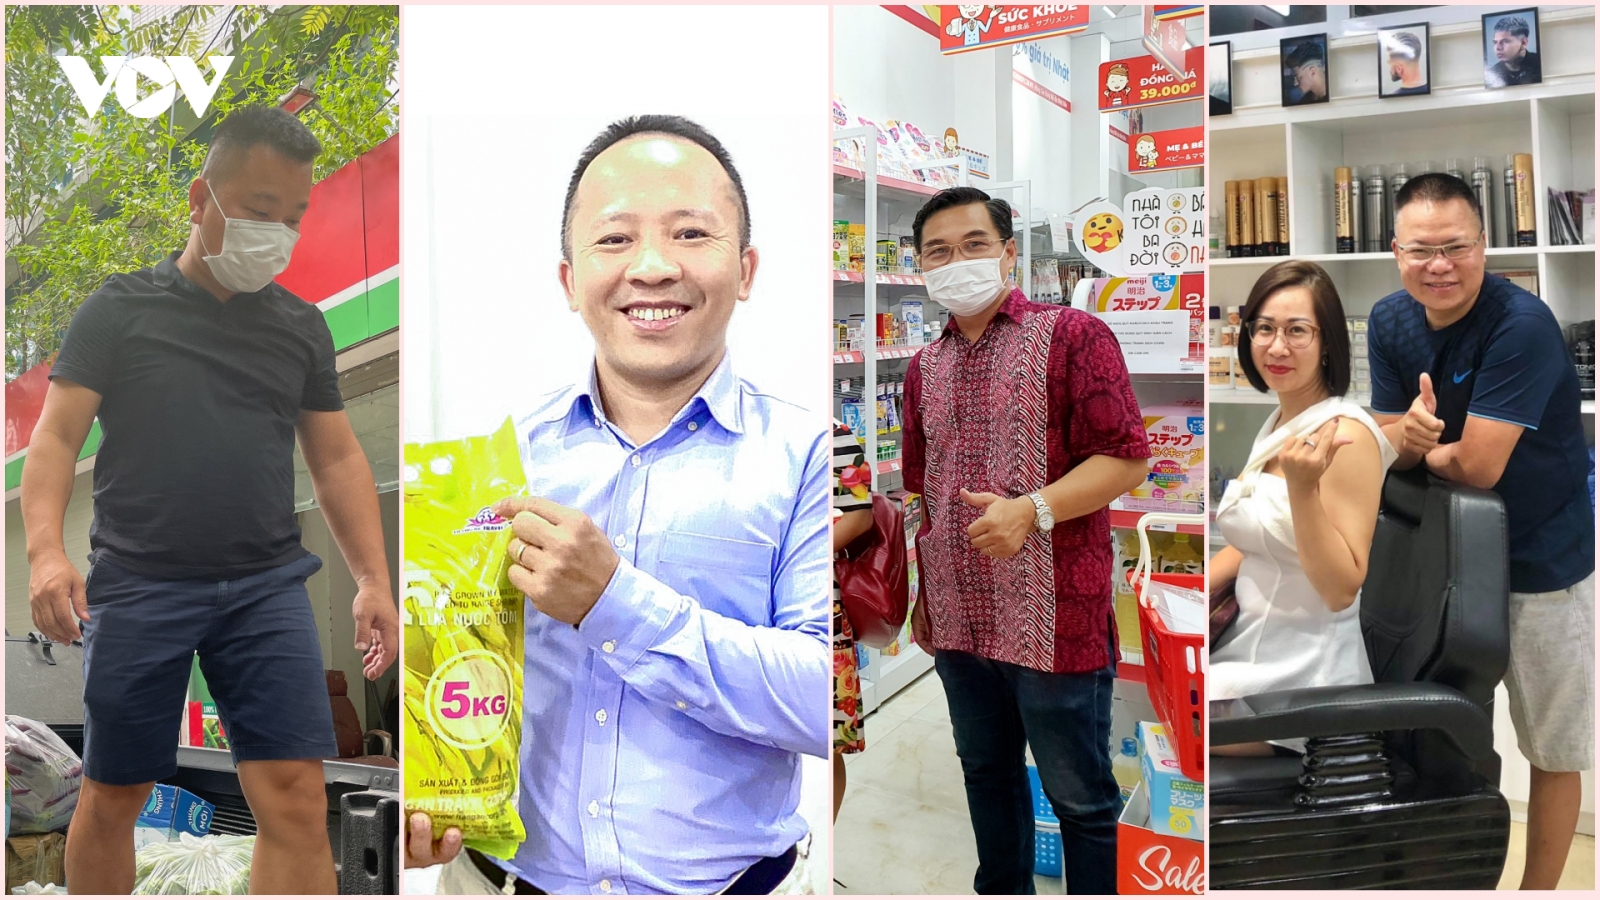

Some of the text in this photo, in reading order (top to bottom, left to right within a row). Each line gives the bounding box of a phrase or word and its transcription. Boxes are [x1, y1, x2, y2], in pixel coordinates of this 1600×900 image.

[998, 7, 1029, 25] SỨC
[1053, 57, 1069, 83] Nhật
[1167, 144, 1180, 152] MẸ
[1191, 140, 1204, 149] BÉ
[1132, 194, 1160, 212] NHÀ
[1132, 214, 1160, 229] TÔI
[1143, 234, 1159, 247] BA
[1130, 250, 1159, 266] ĐỜI
[1127, 277, 1147, 285] meiji
[1127, 287, 1145, 295] 明治
[1113, 296, 1161, 311] ステップ
[1148, 433, 1194, 446] ステップ
[455, 591, 484, 600] GROWN
[496, 608, 517, 625] TÔM
[1131, 845, 1204, 895] Sale
